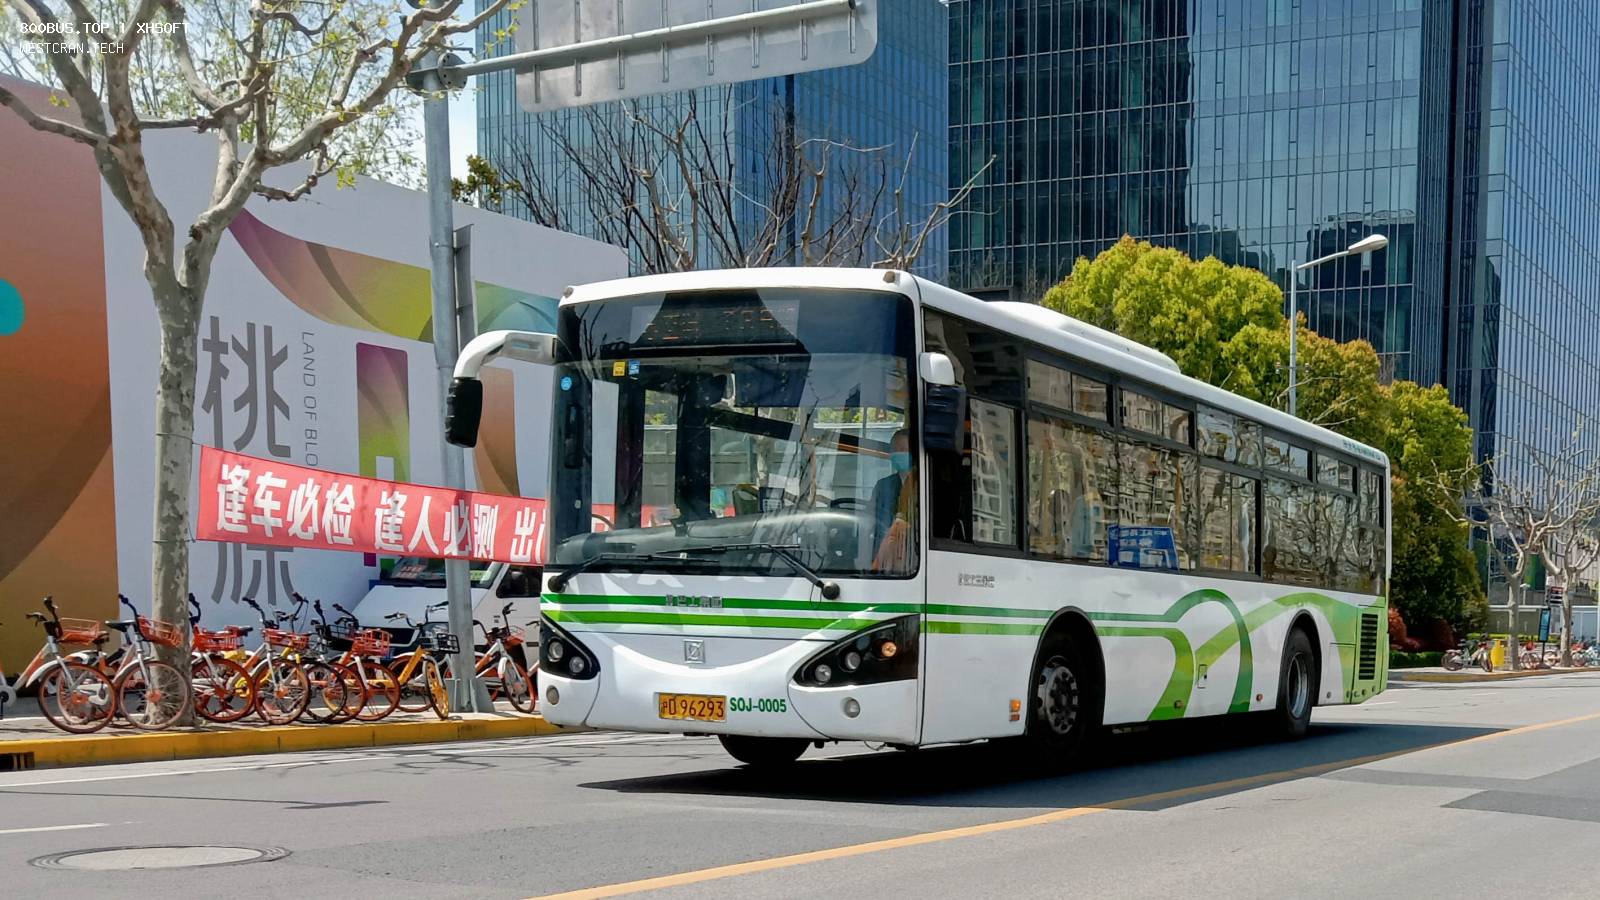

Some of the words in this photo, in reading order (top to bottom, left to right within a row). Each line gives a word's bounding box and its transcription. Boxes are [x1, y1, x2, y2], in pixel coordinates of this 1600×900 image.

[302, 331, 316, 387] LAND
[303, 395, 317, 421] OF
[216, 463, 356, 546] 逢车必检
[374, 490, 499, 559] 逢人必测
[509, 506, 546, 564] 出
[729, 696, 788, 713] SOJ-0005
